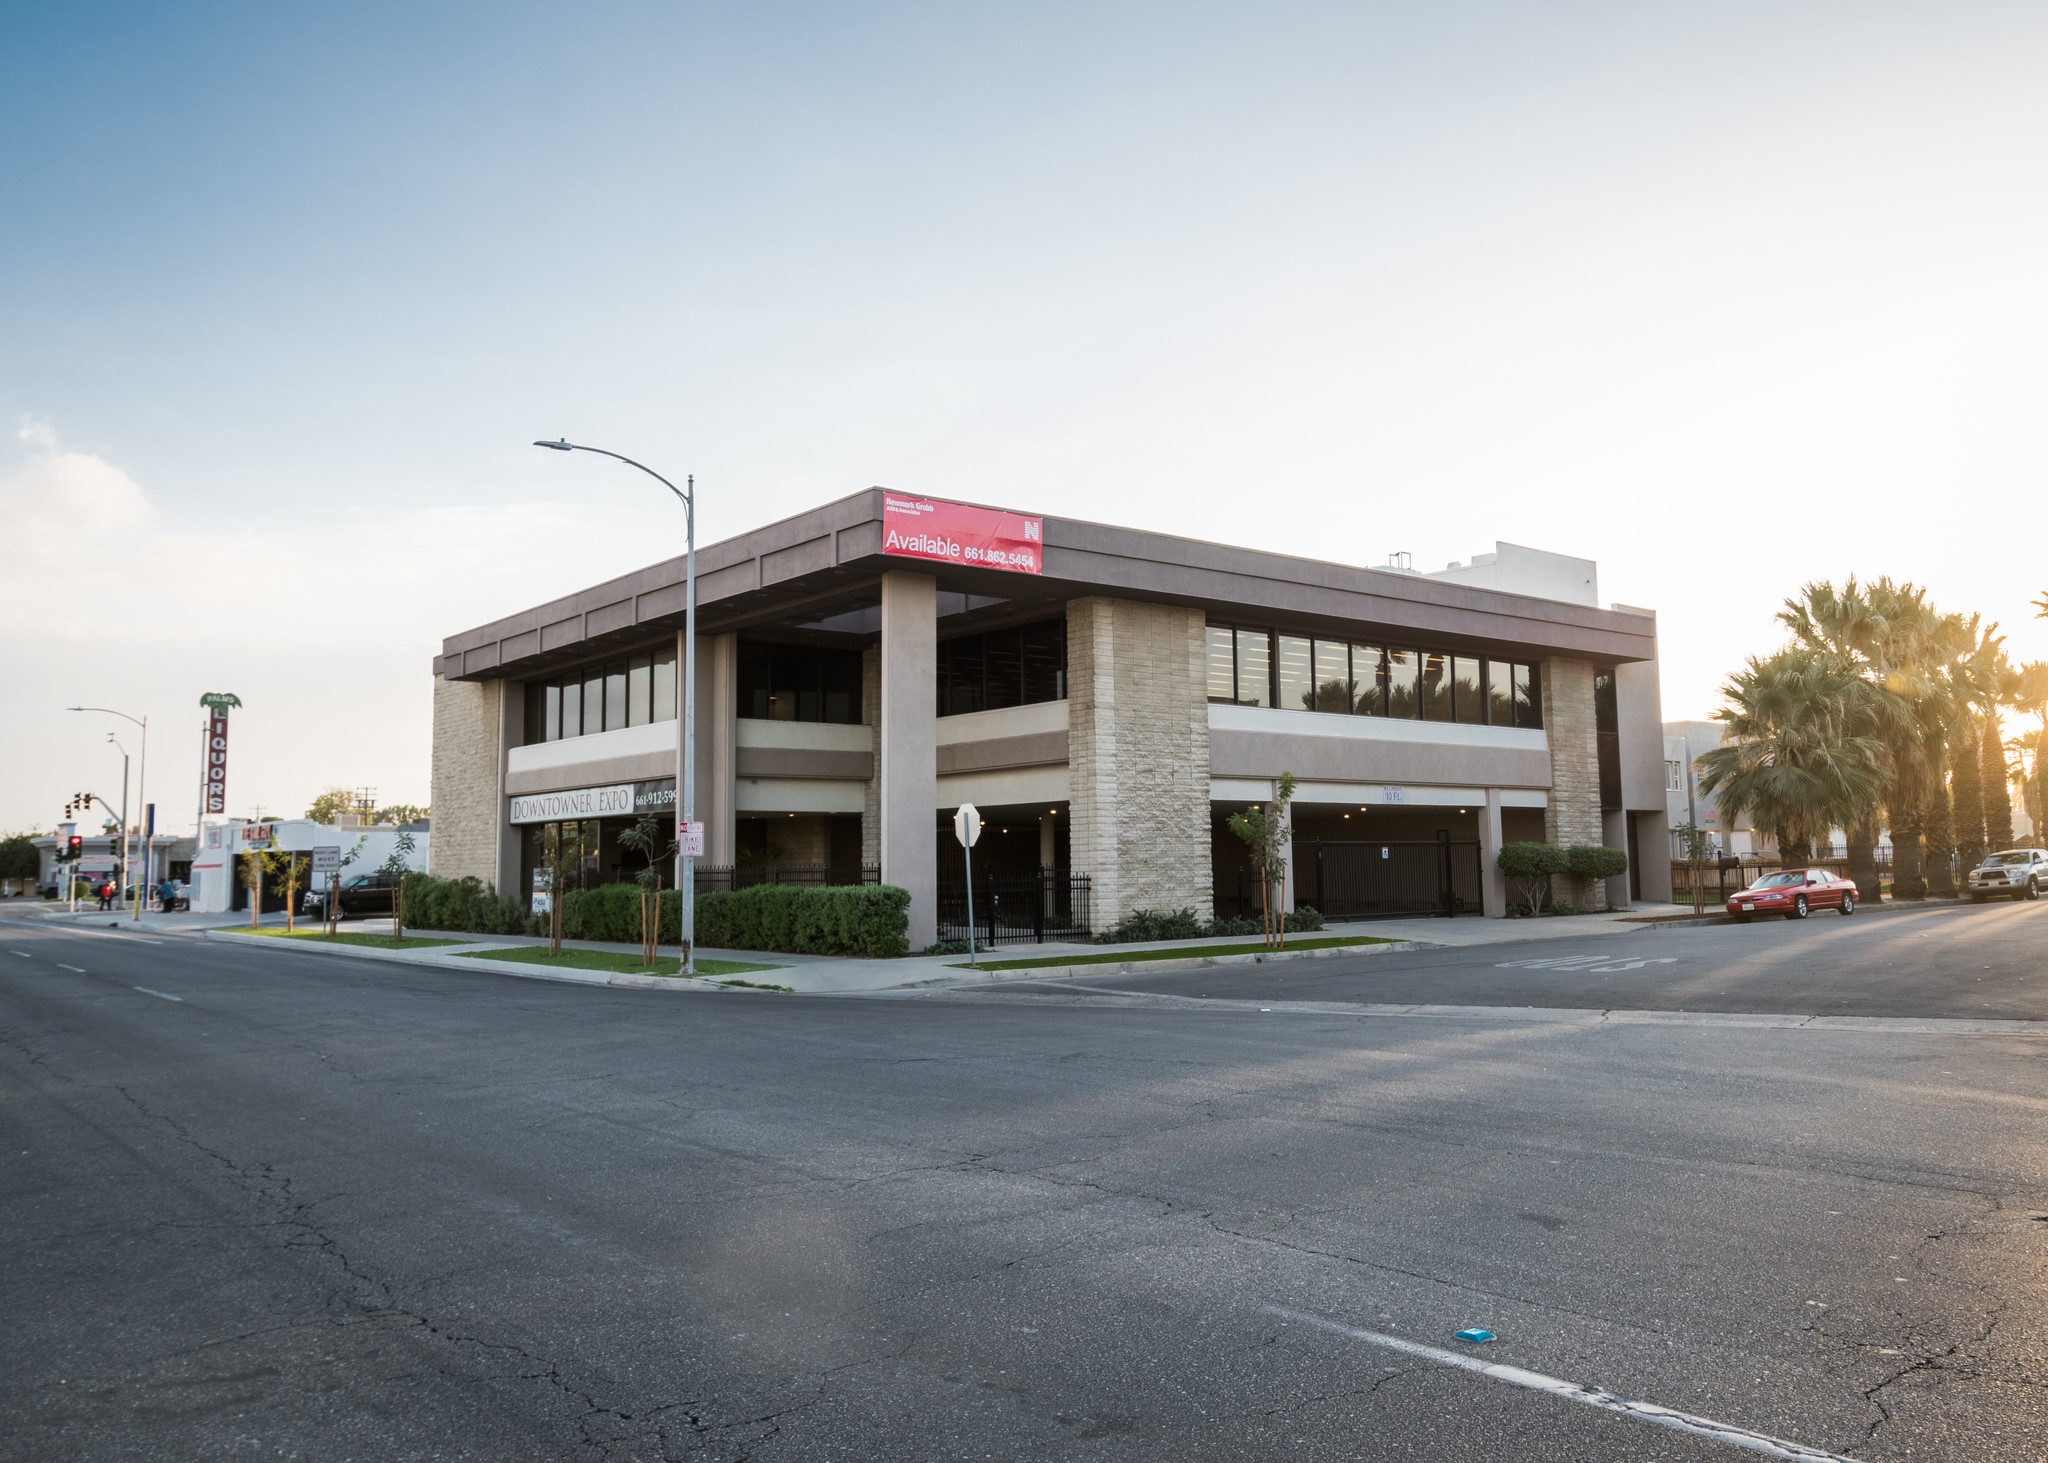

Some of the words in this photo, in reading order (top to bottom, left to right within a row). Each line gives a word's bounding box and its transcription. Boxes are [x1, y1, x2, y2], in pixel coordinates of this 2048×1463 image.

[886, 497, 915, 509] Newmark
[915, 502, 934, 512] Grubb
[885, 530, 961, 557] Available
[964, 547, 1034, 568] 661.862.5454
[206, 694, 235, 704] PALMS
[209, 707, 227, 811] LIQUORS
[1385, 792, 1392, 801] 10
[514, 792, 593, 820] DOWNTOWNER
[599, 789, 629, 812] EXPO
[680, 824, 687, 832] NO
